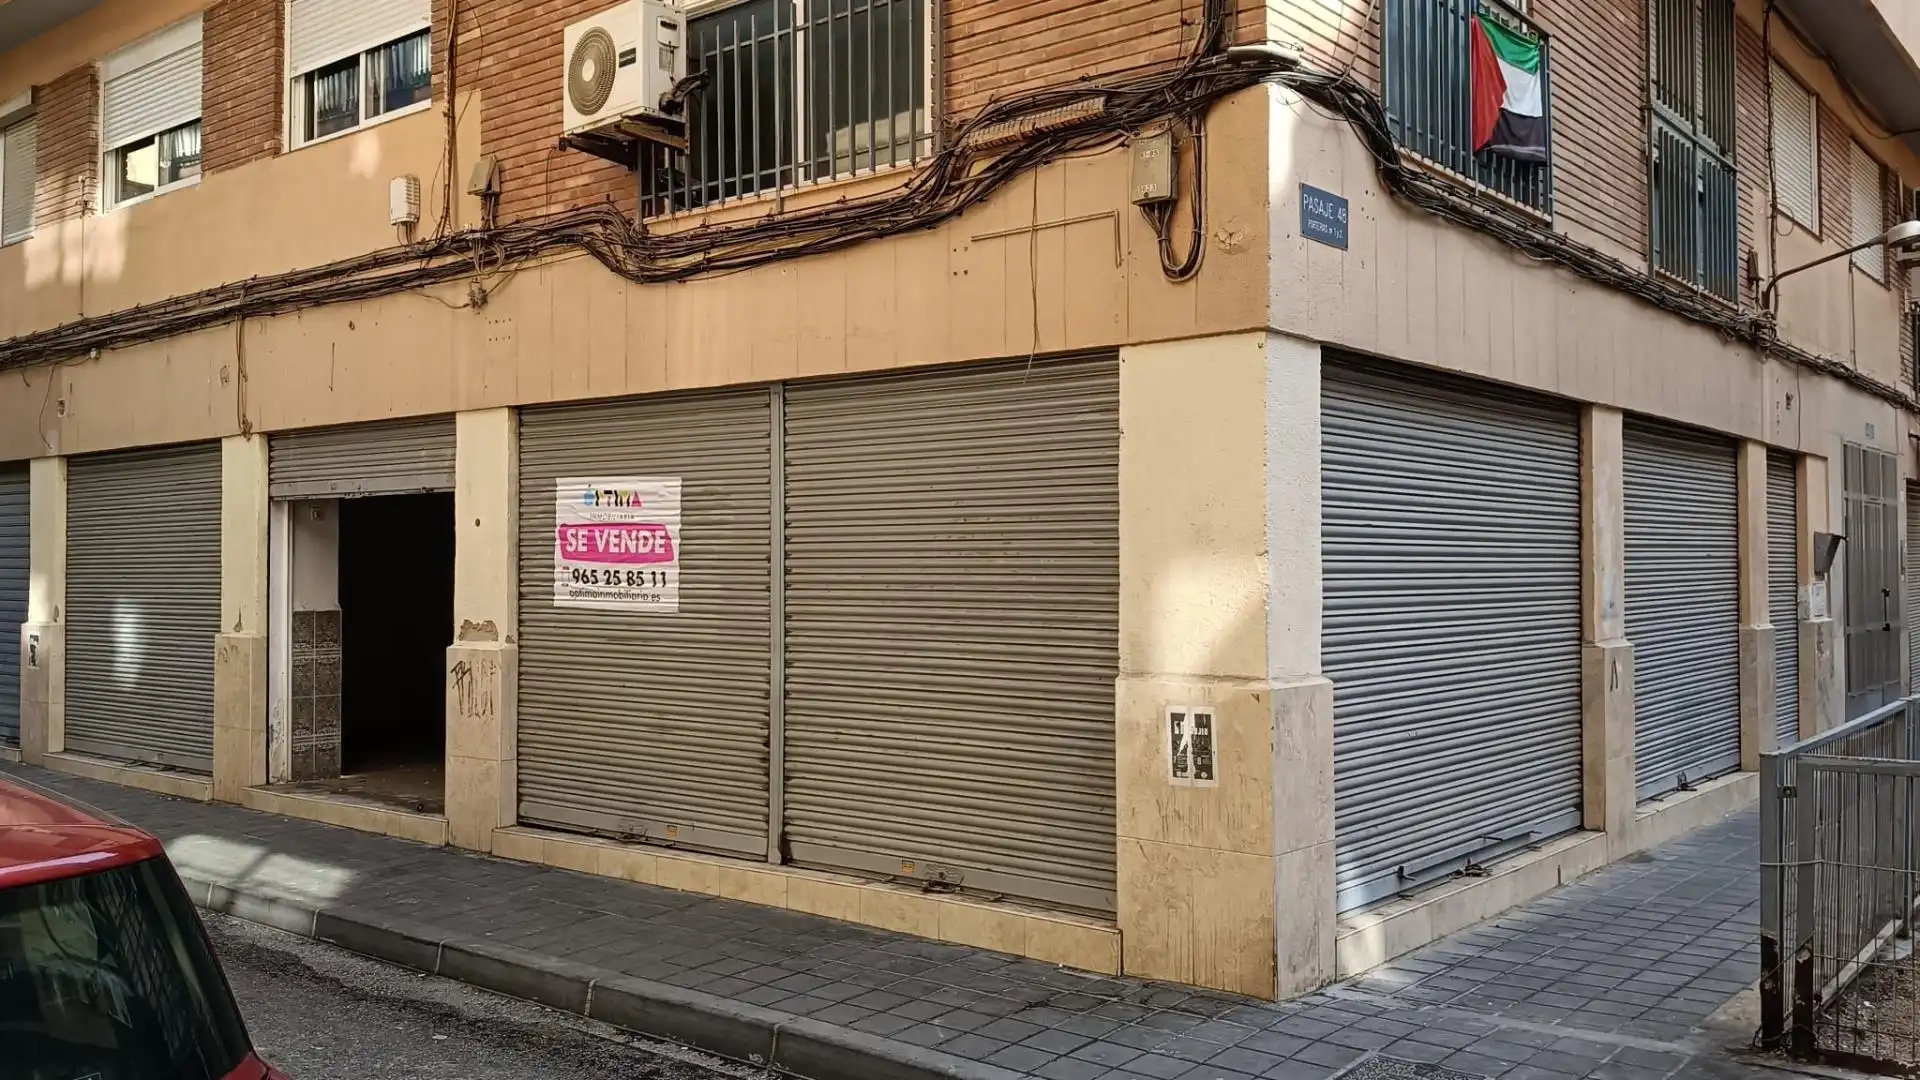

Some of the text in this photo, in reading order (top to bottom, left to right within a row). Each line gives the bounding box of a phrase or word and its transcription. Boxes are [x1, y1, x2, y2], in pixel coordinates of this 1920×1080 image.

[1303, 193, 1334, 219] PASAJE
[566, 528, 666, 554] SE VENDE
[572, 568, 667, 588] 965 25 85 11
